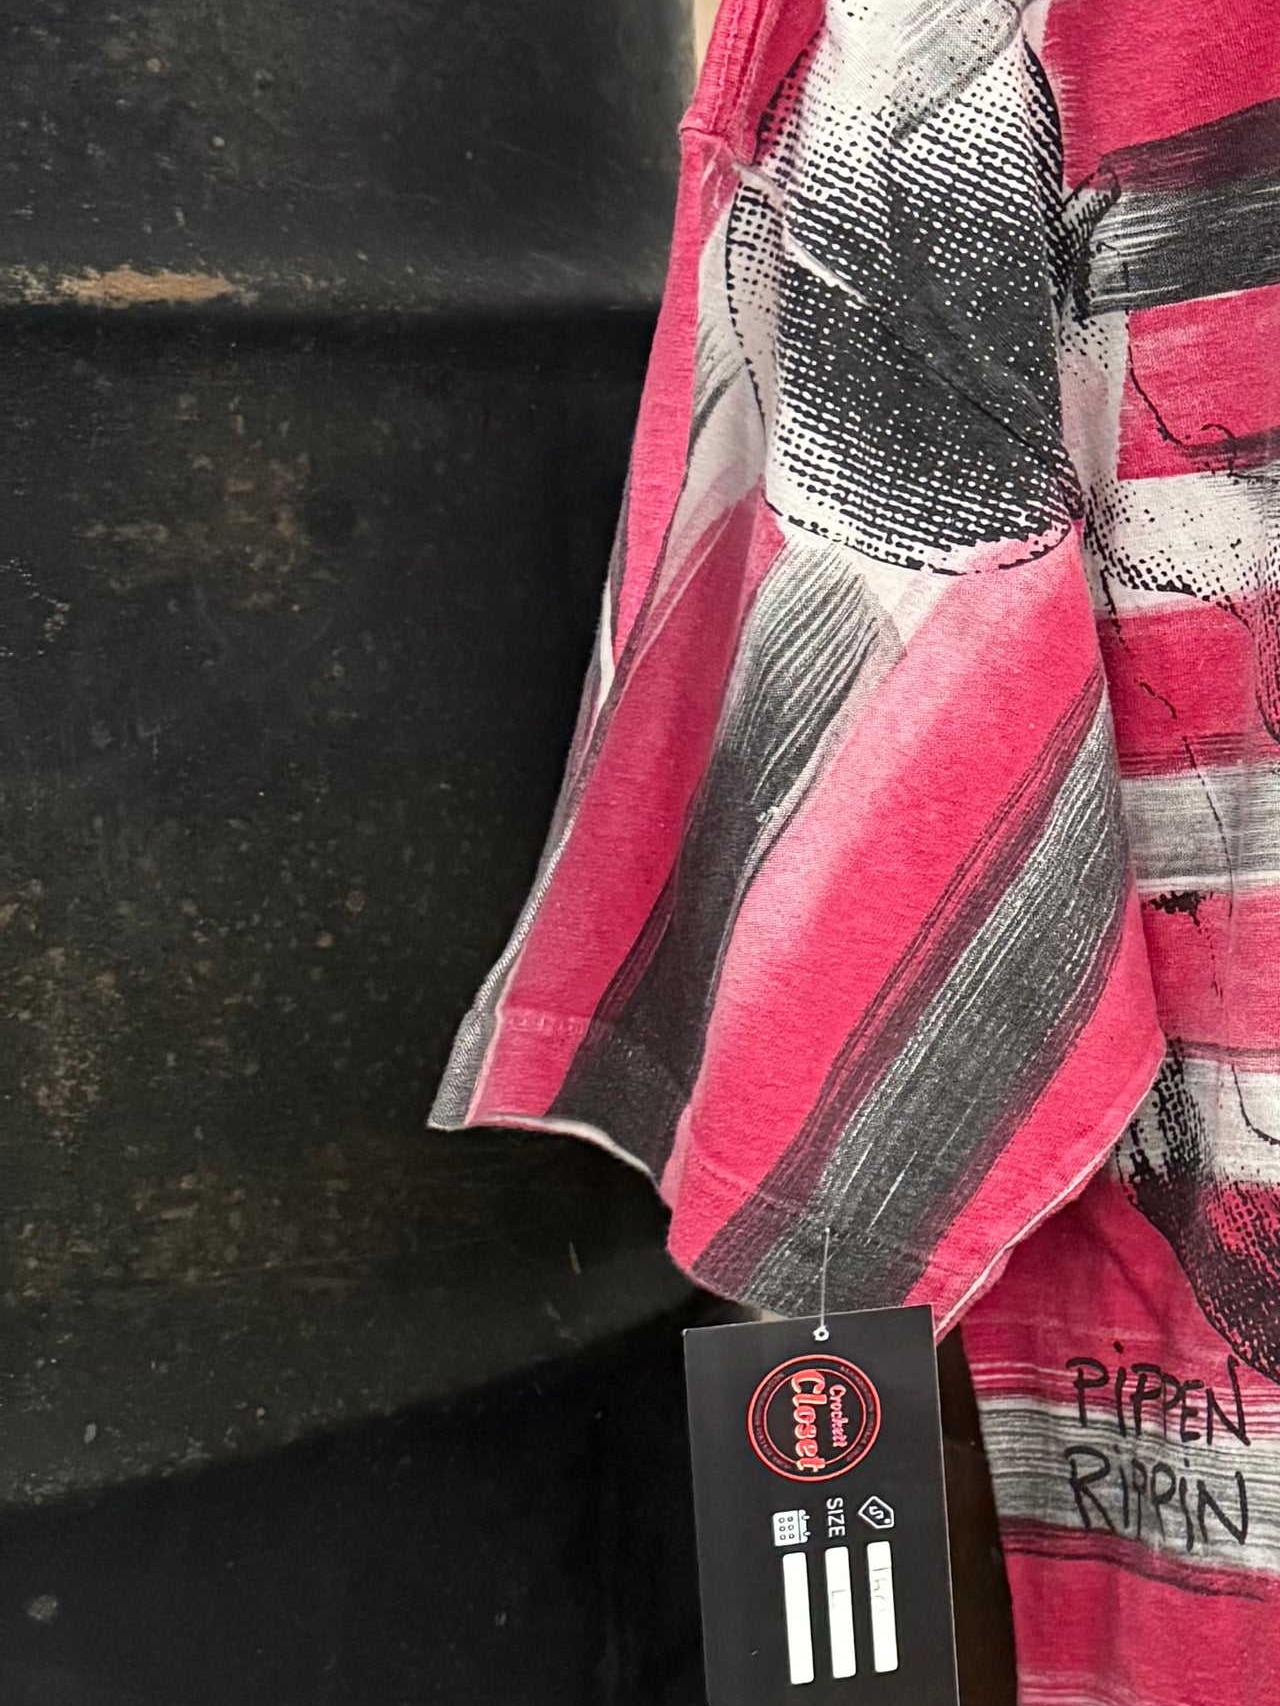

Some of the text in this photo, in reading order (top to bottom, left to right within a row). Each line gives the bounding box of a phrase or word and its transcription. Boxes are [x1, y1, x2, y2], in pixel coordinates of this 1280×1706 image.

[791, 1369, 826, 1475] Closet
[828, 1383, 850, 1449] Crockett
[825, 1496, 846, 1539] SIZE
